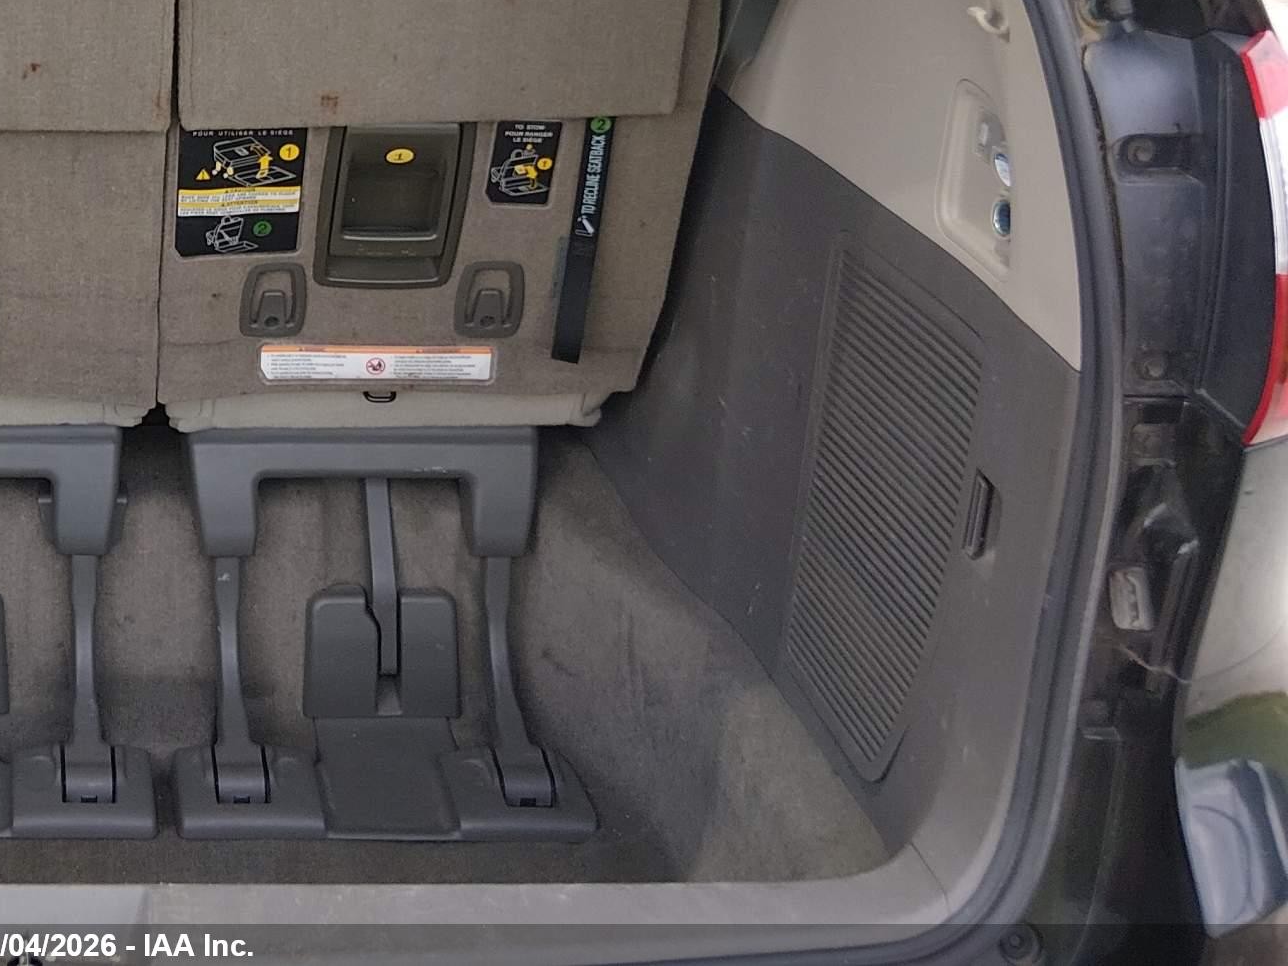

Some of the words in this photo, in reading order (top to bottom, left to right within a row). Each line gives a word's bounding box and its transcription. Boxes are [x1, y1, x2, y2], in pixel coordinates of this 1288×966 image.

[587, 134, 606, 173] SEATBACK
[583, 174, 601, 205] RECLINE
[581, 204, 596, 214] TO
